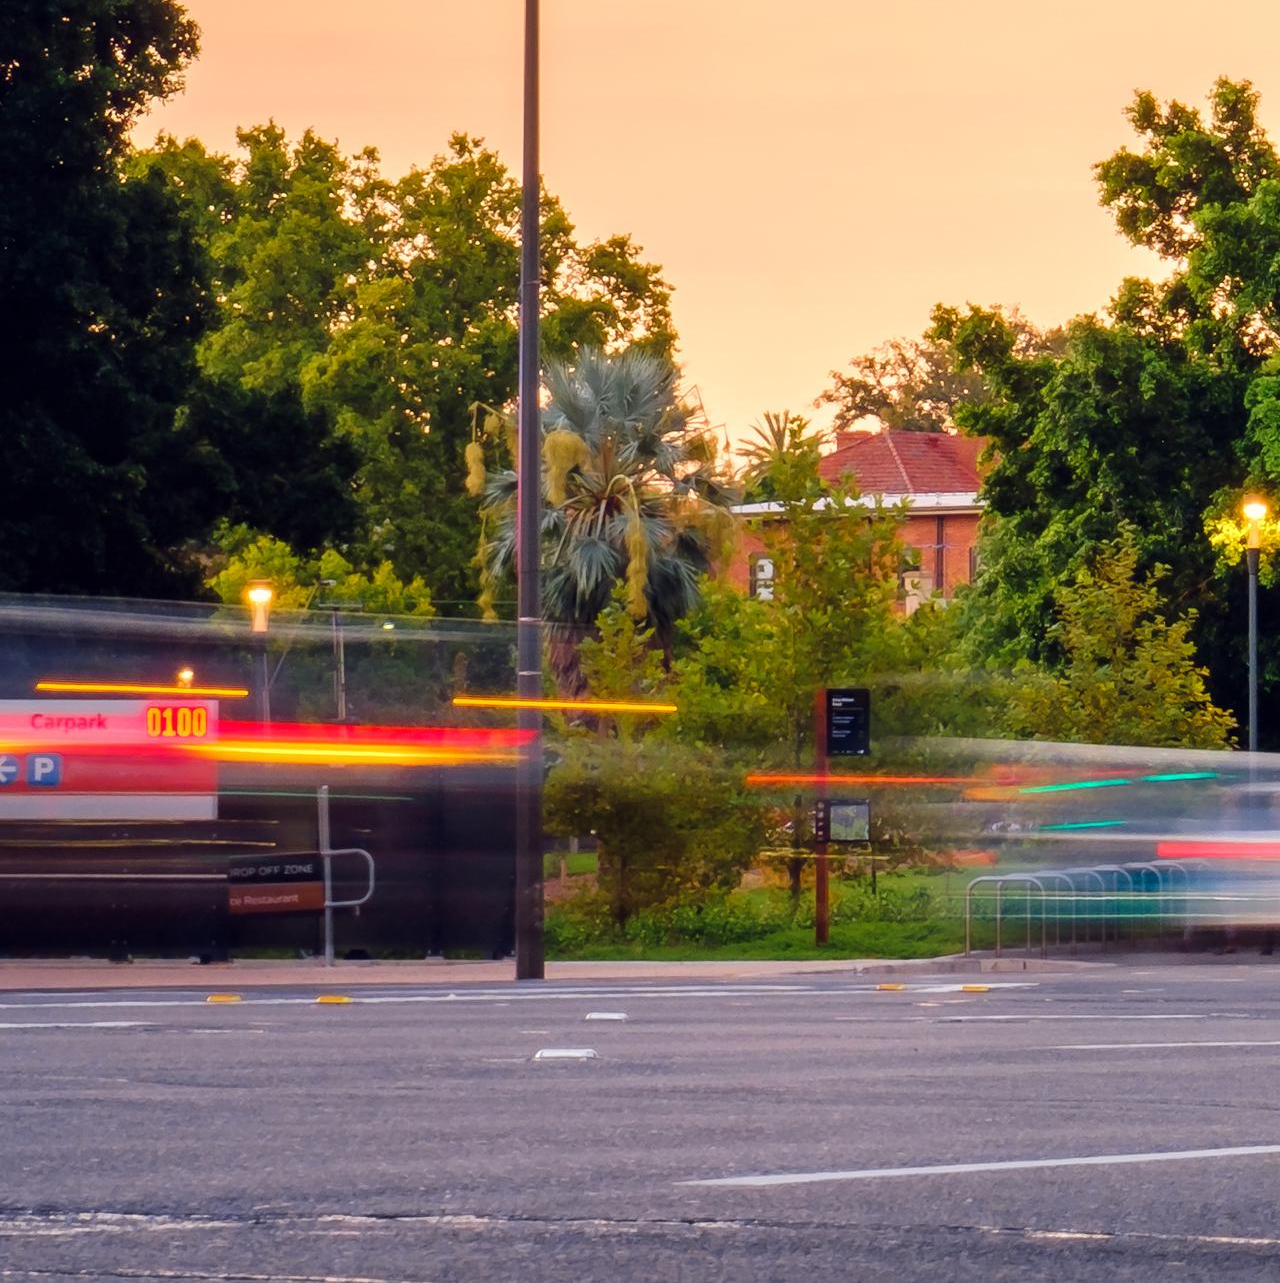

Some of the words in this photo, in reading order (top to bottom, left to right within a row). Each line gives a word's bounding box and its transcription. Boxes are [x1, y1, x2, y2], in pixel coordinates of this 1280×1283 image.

[31, 714, 108, 733] Carpark
[146, 706, 207, 738] 0100
[258, 866, 280, 875] OFF
[284, 864, 313, 874] ZONE
[243, 894, 299, 905] Restaurant
